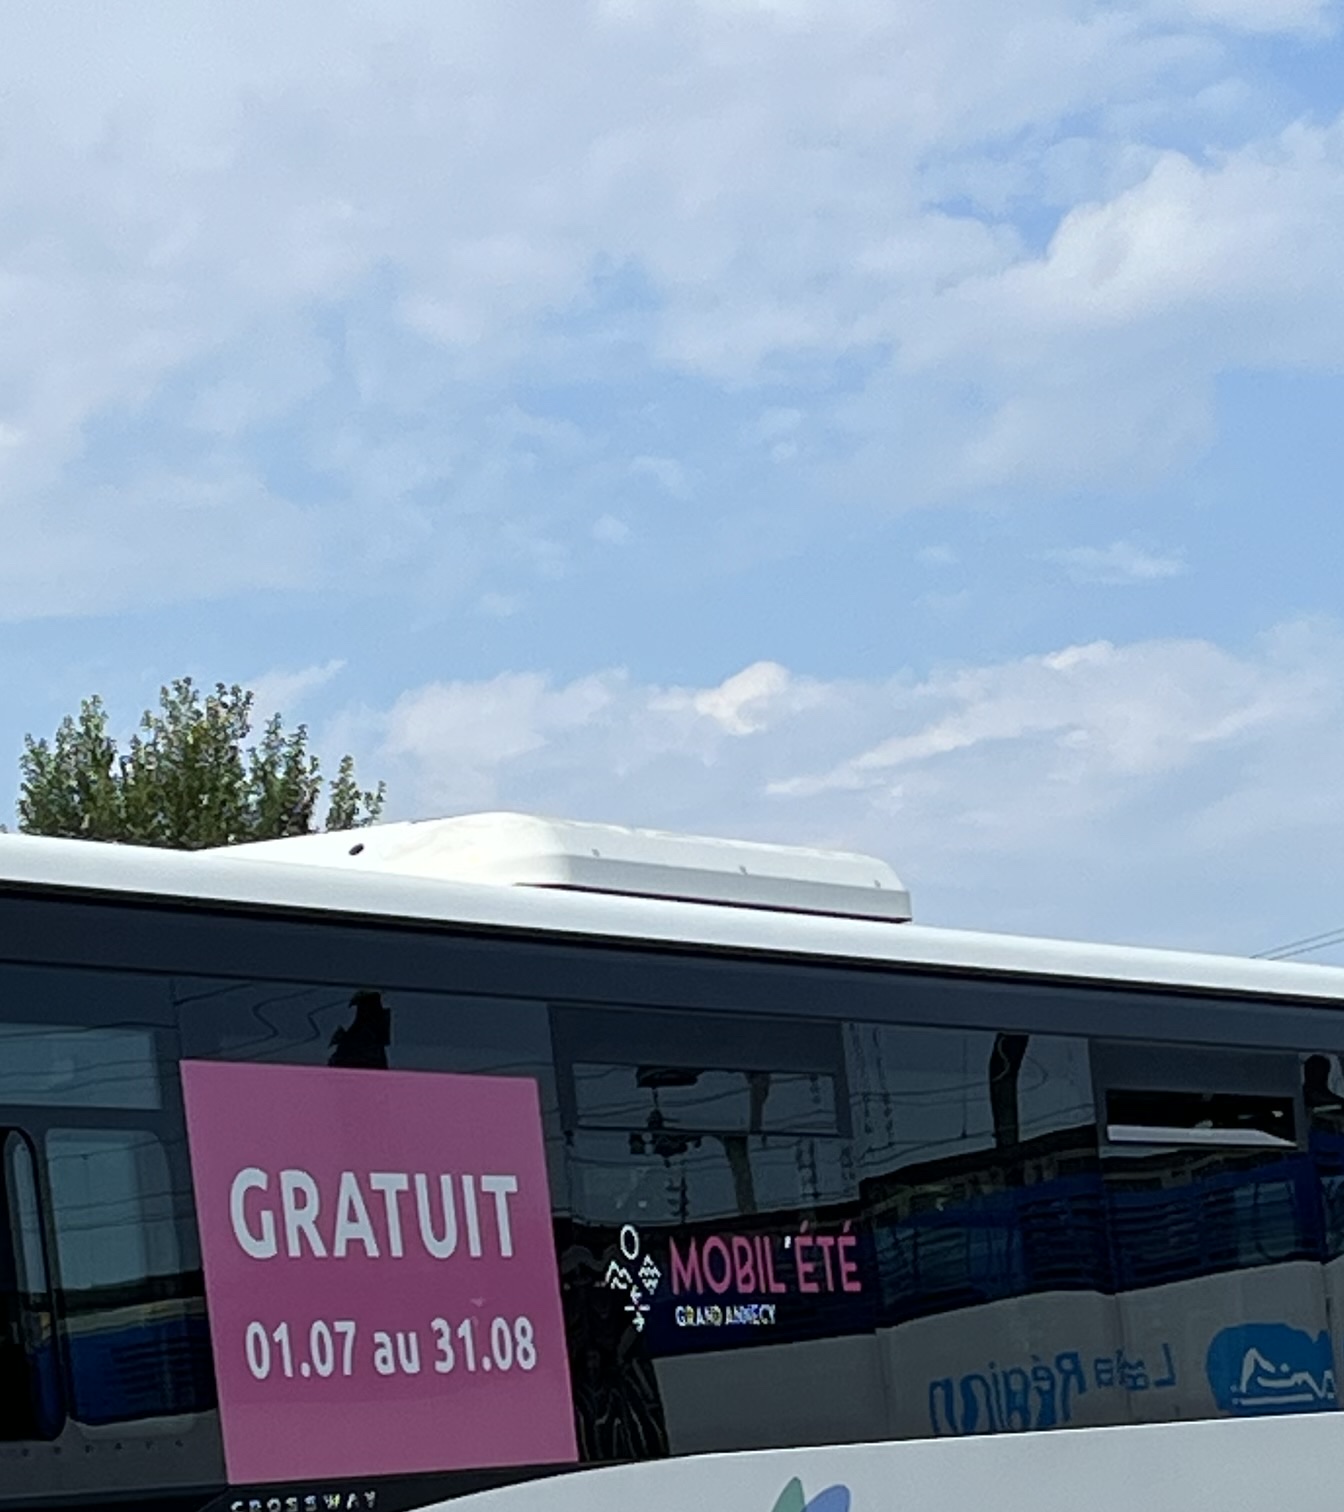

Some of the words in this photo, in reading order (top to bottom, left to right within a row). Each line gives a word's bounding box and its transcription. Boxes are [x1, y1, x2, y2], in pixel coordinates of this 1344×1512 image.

[229, 1168, 518, 1258] GRATUIT
[669, 1220, 862, 1295] MOBIL'ÉTÉ
[246, 1322, 357, 1379] 01.07
[373, 1332, 420, 1375] au
[434, 1316, 537, 1371] 31.08
[675, 1305, 722, 1326] GRAND
[725, 1304, 776, 1325] ANNECY
